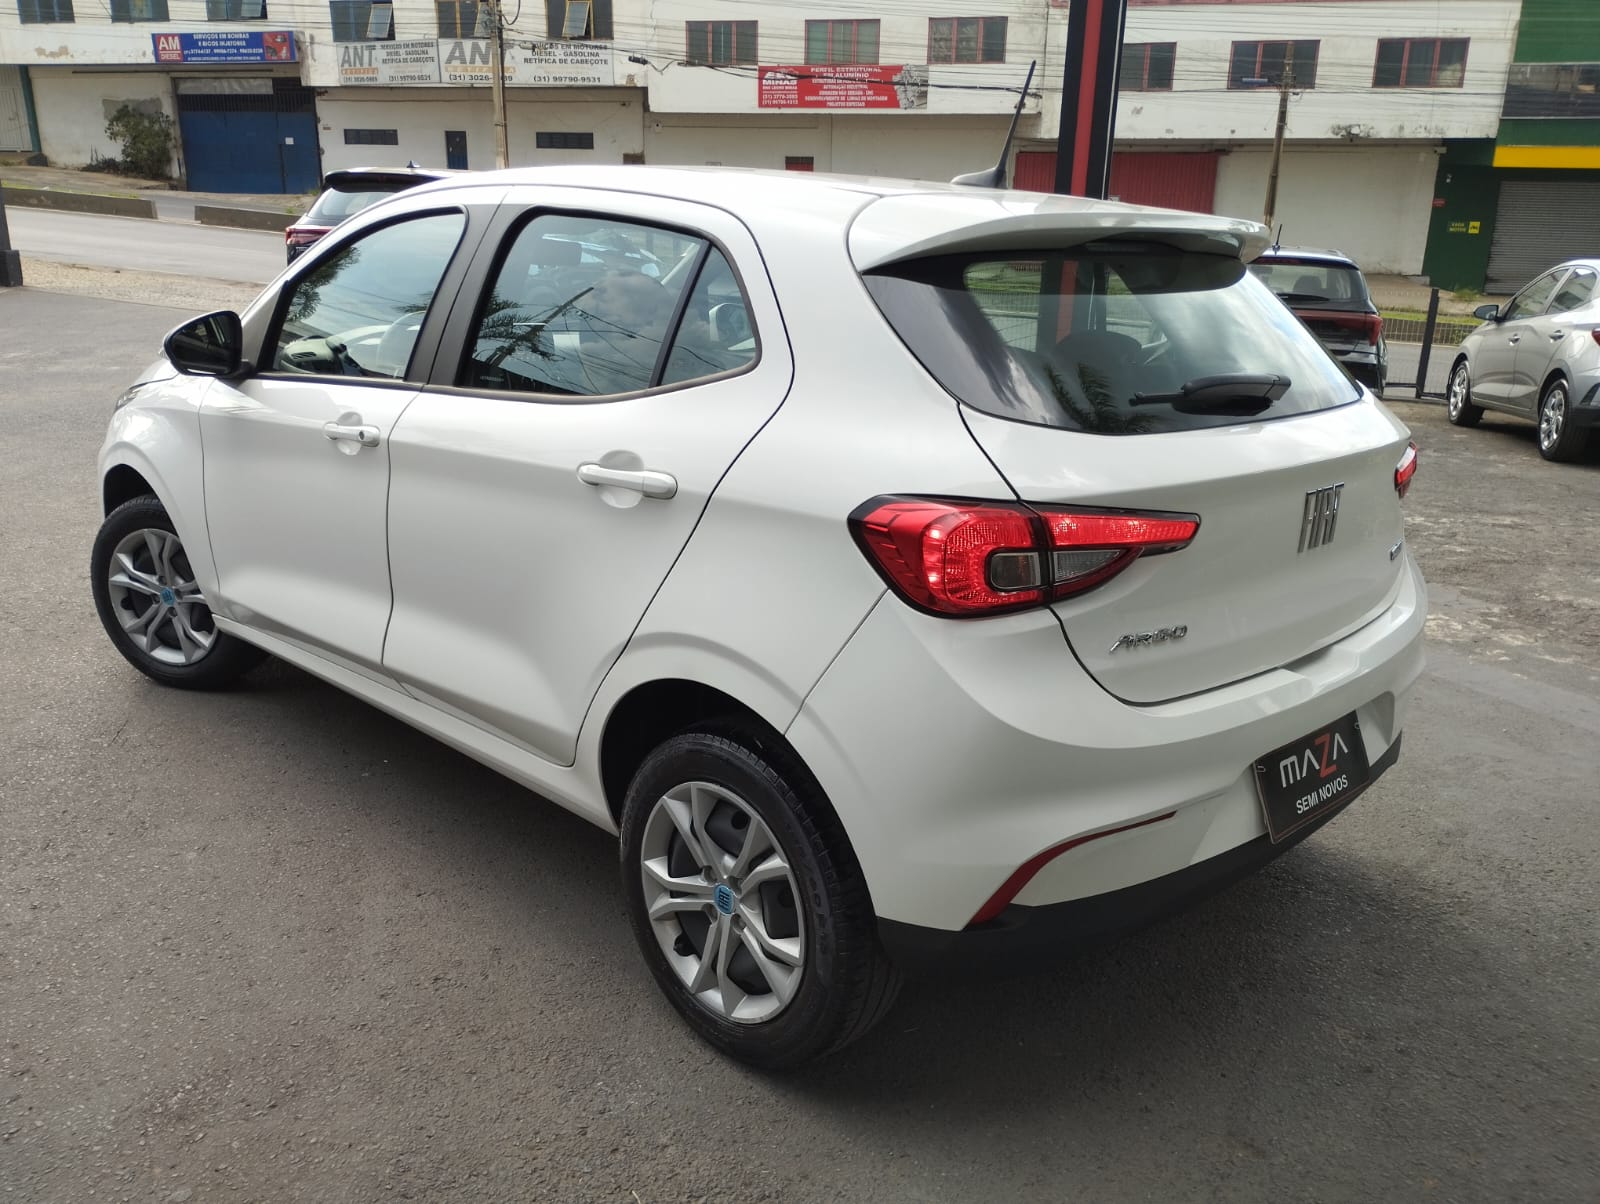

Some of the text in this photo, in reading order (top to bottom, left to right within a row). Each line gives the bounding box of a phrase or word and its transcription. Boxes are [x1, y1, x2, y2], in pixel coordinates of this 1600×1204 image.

[159, 36, 181, 50] AM
[340, 45, 377, 67] ANT
[570, 58, 608, 66] CABEÇOTE
[449, 73, 465, 81] (31)
[533, 75, 550, 83] (31)
[1109, 625, 1188, 652] ARGO
[1279, 732, 1349, 788] MAZA
[1296, 774, 1349, 814] SEMI NOVOS
